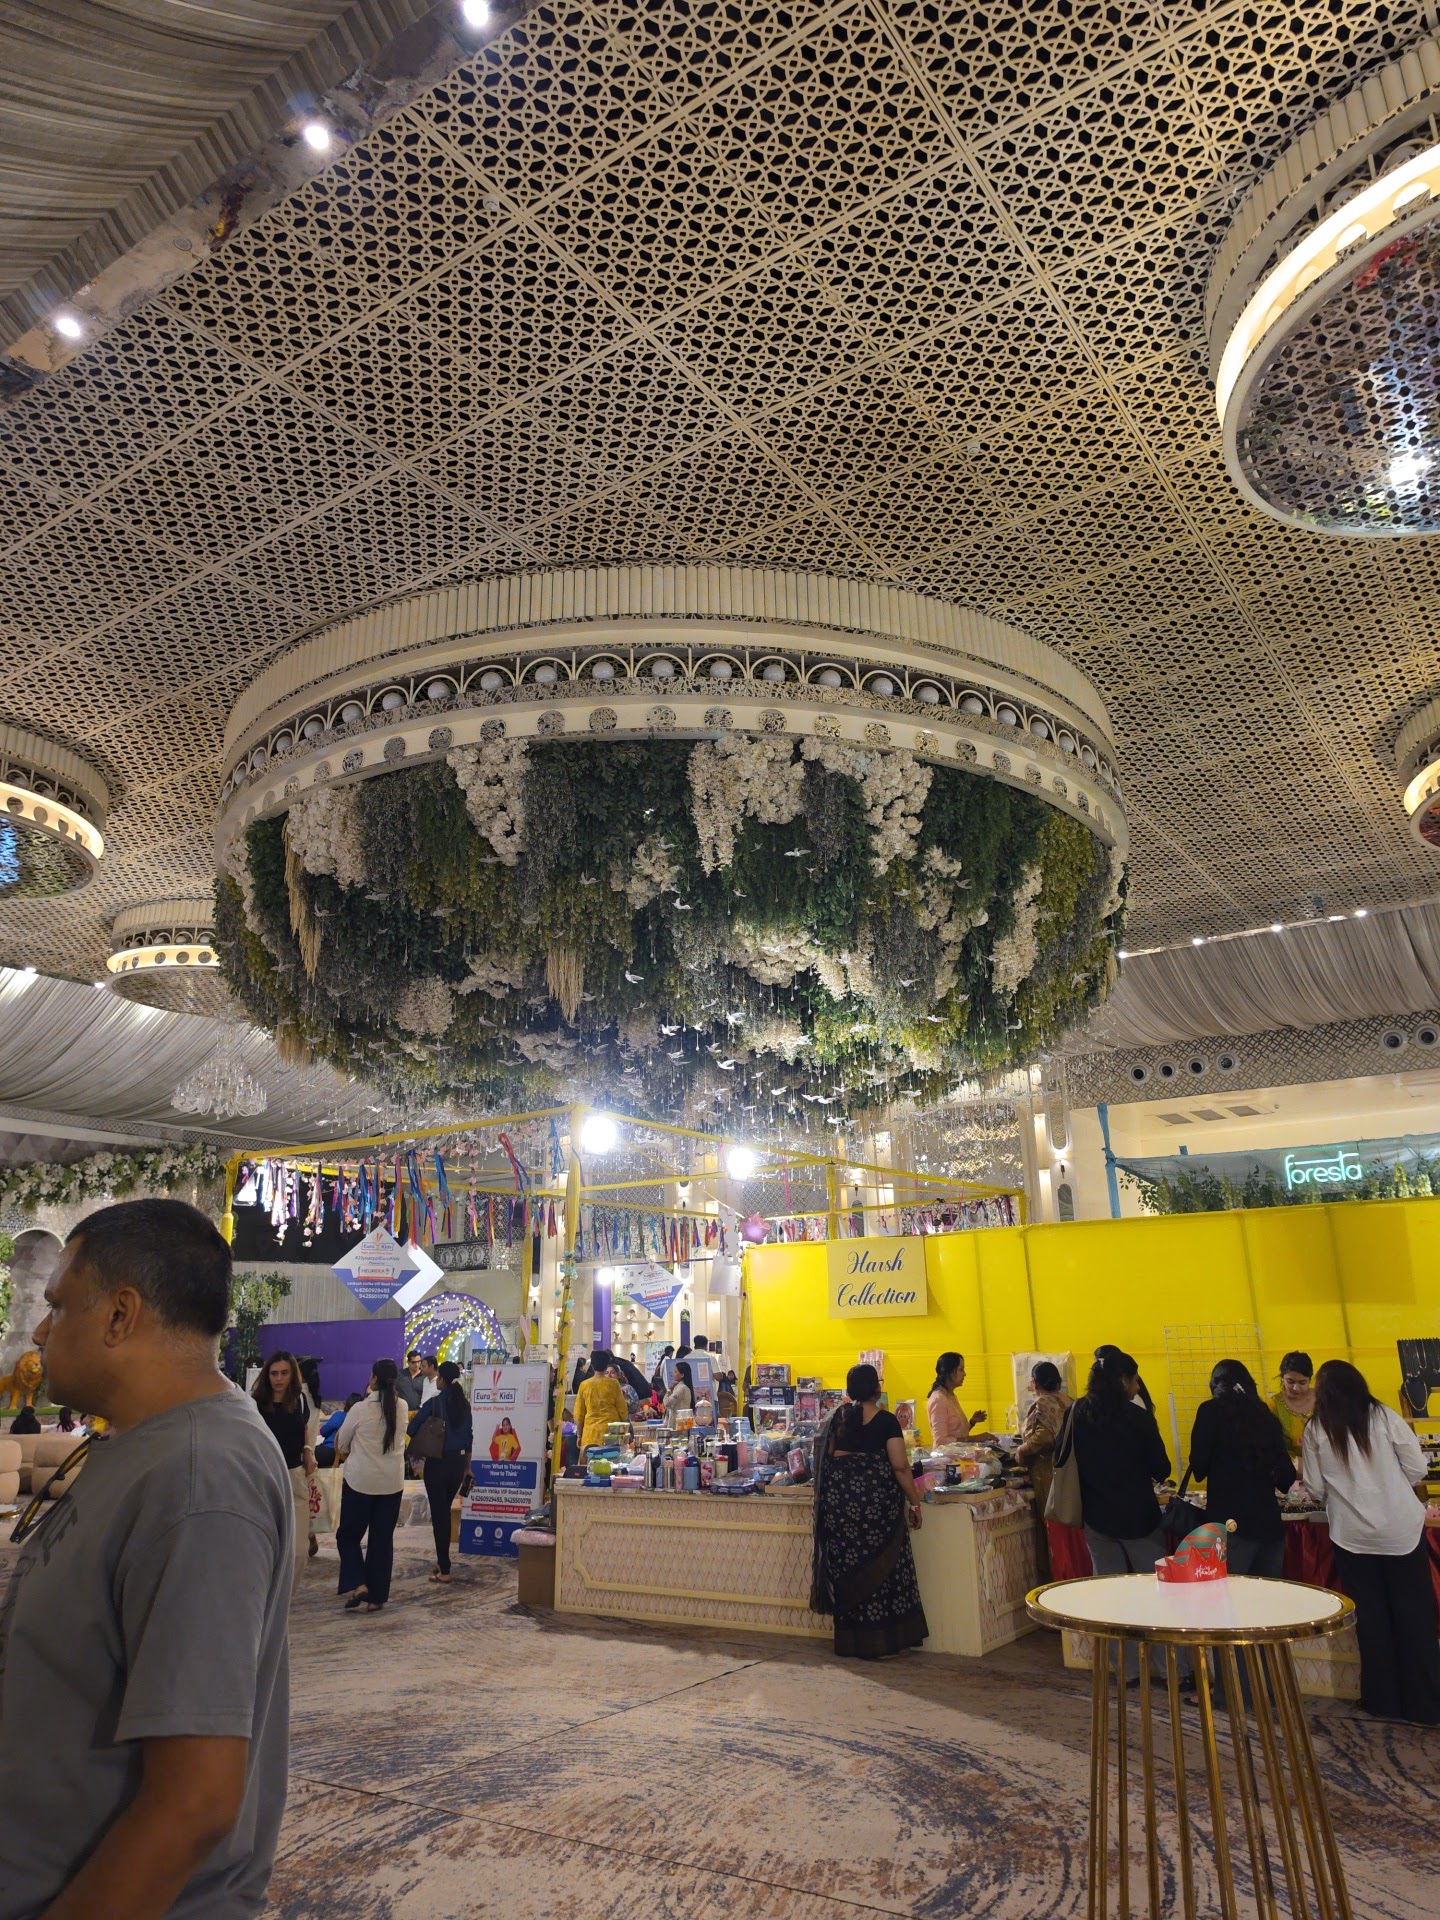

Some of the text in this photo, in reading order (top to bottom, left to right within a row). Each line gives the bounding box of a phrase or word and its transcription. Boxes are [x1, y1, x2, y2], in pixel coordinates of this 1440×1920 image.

[1285, 1150, 1362, 1190] foresta
[847, 1248, 905, 1274] Harsh
[837, 1282, 917, 1307] Collection
[476, 1392, 513, 1400] Euro Kids
